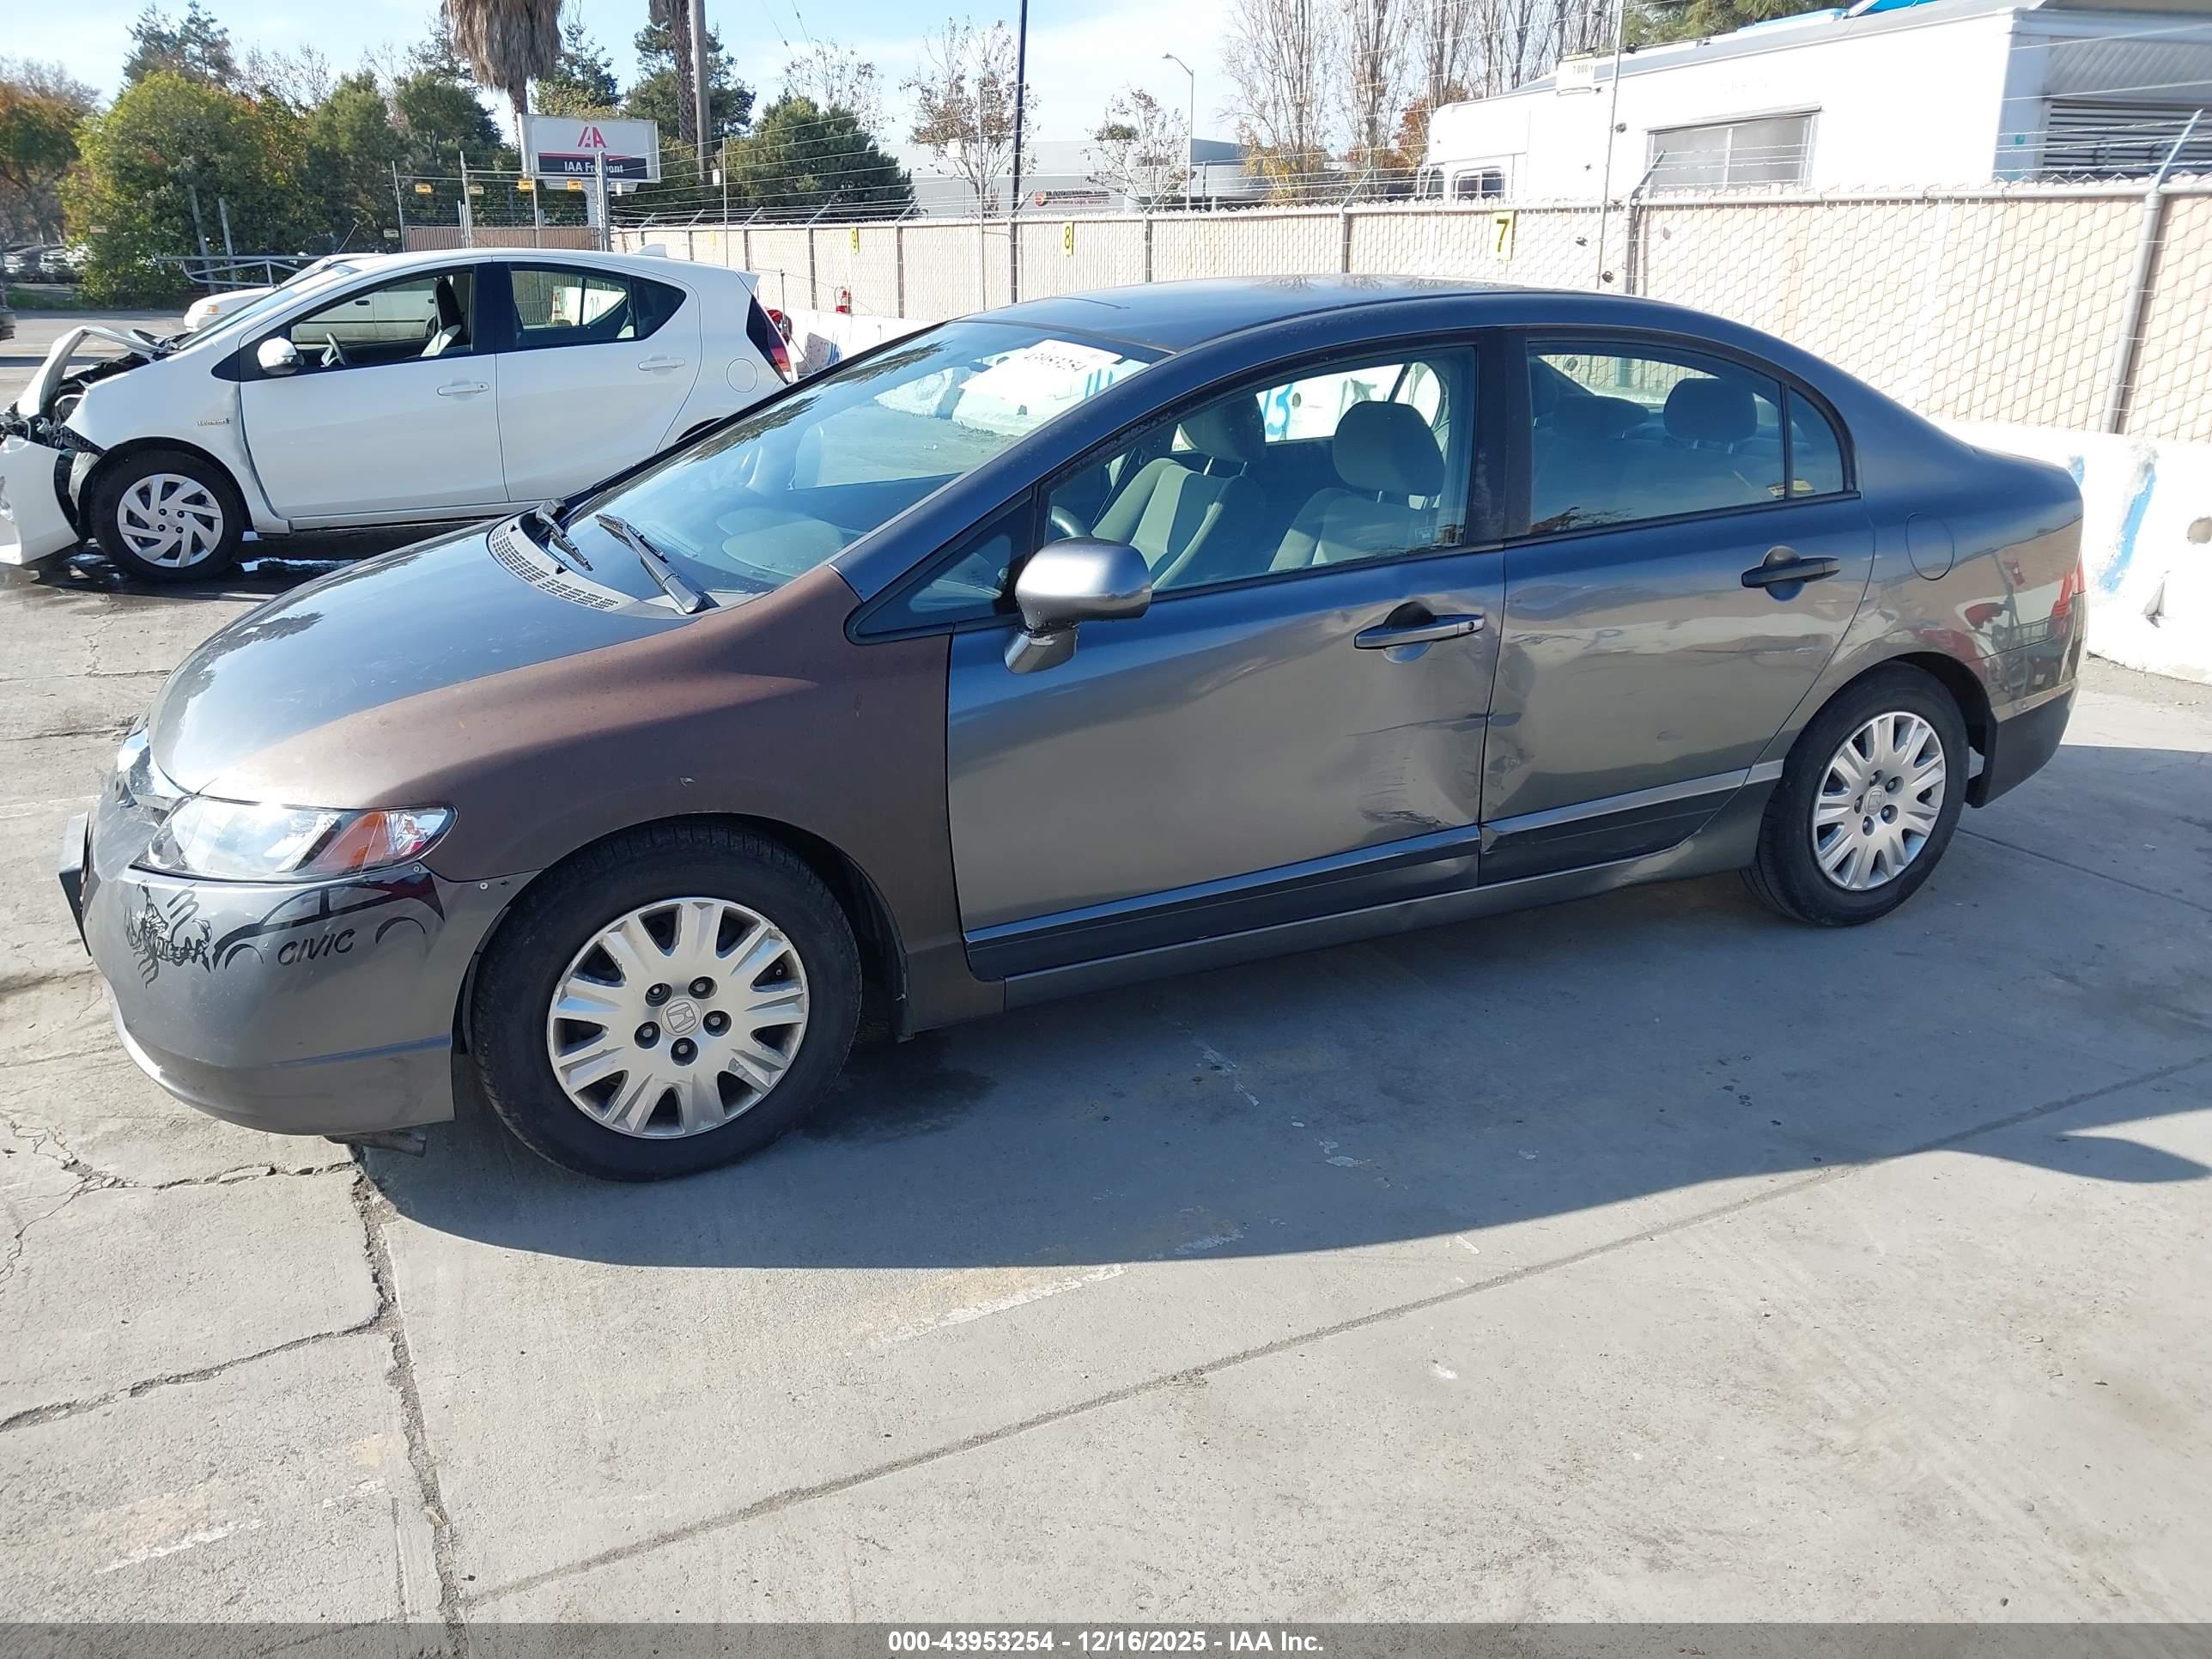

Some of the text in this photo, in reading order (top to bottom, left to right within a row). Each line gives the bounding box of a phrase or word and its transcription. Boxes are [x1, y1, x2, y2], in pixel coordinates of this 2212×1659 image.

[563, 161, 583, 172] IAA
[1065, 226, 1071, 249] 8
[1497, 218, 1510, 252] 7
[277, 928, 356, 966] CIVIC
